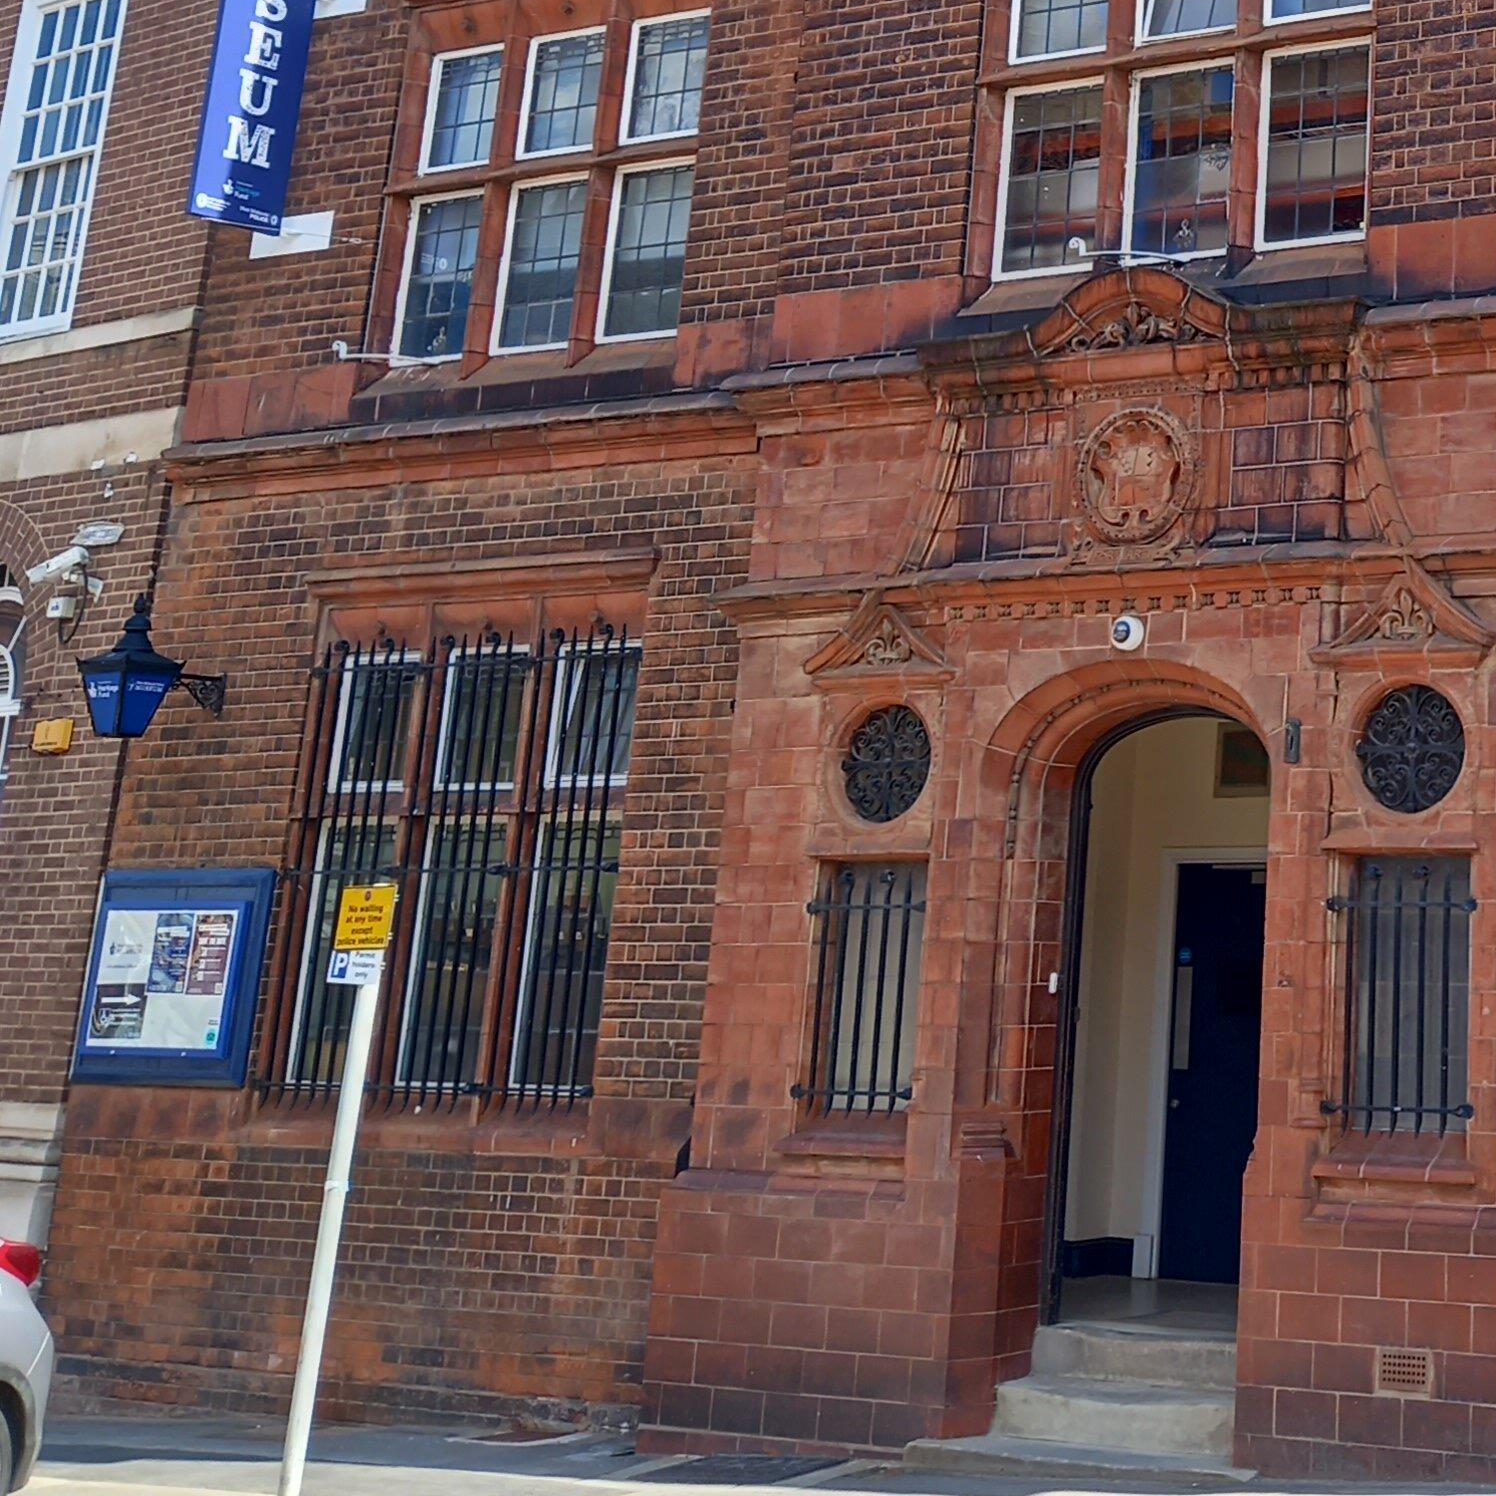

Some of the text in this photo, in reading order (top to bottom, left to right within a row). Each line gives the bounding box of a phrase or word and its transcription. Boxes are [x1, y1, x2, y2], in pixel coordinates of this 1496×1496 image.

[360, 905, 383, 913] waiting
[355, 916, 366, 924] any
[351, 926, 373, 934] except
[333, 952, 349, 976] P
